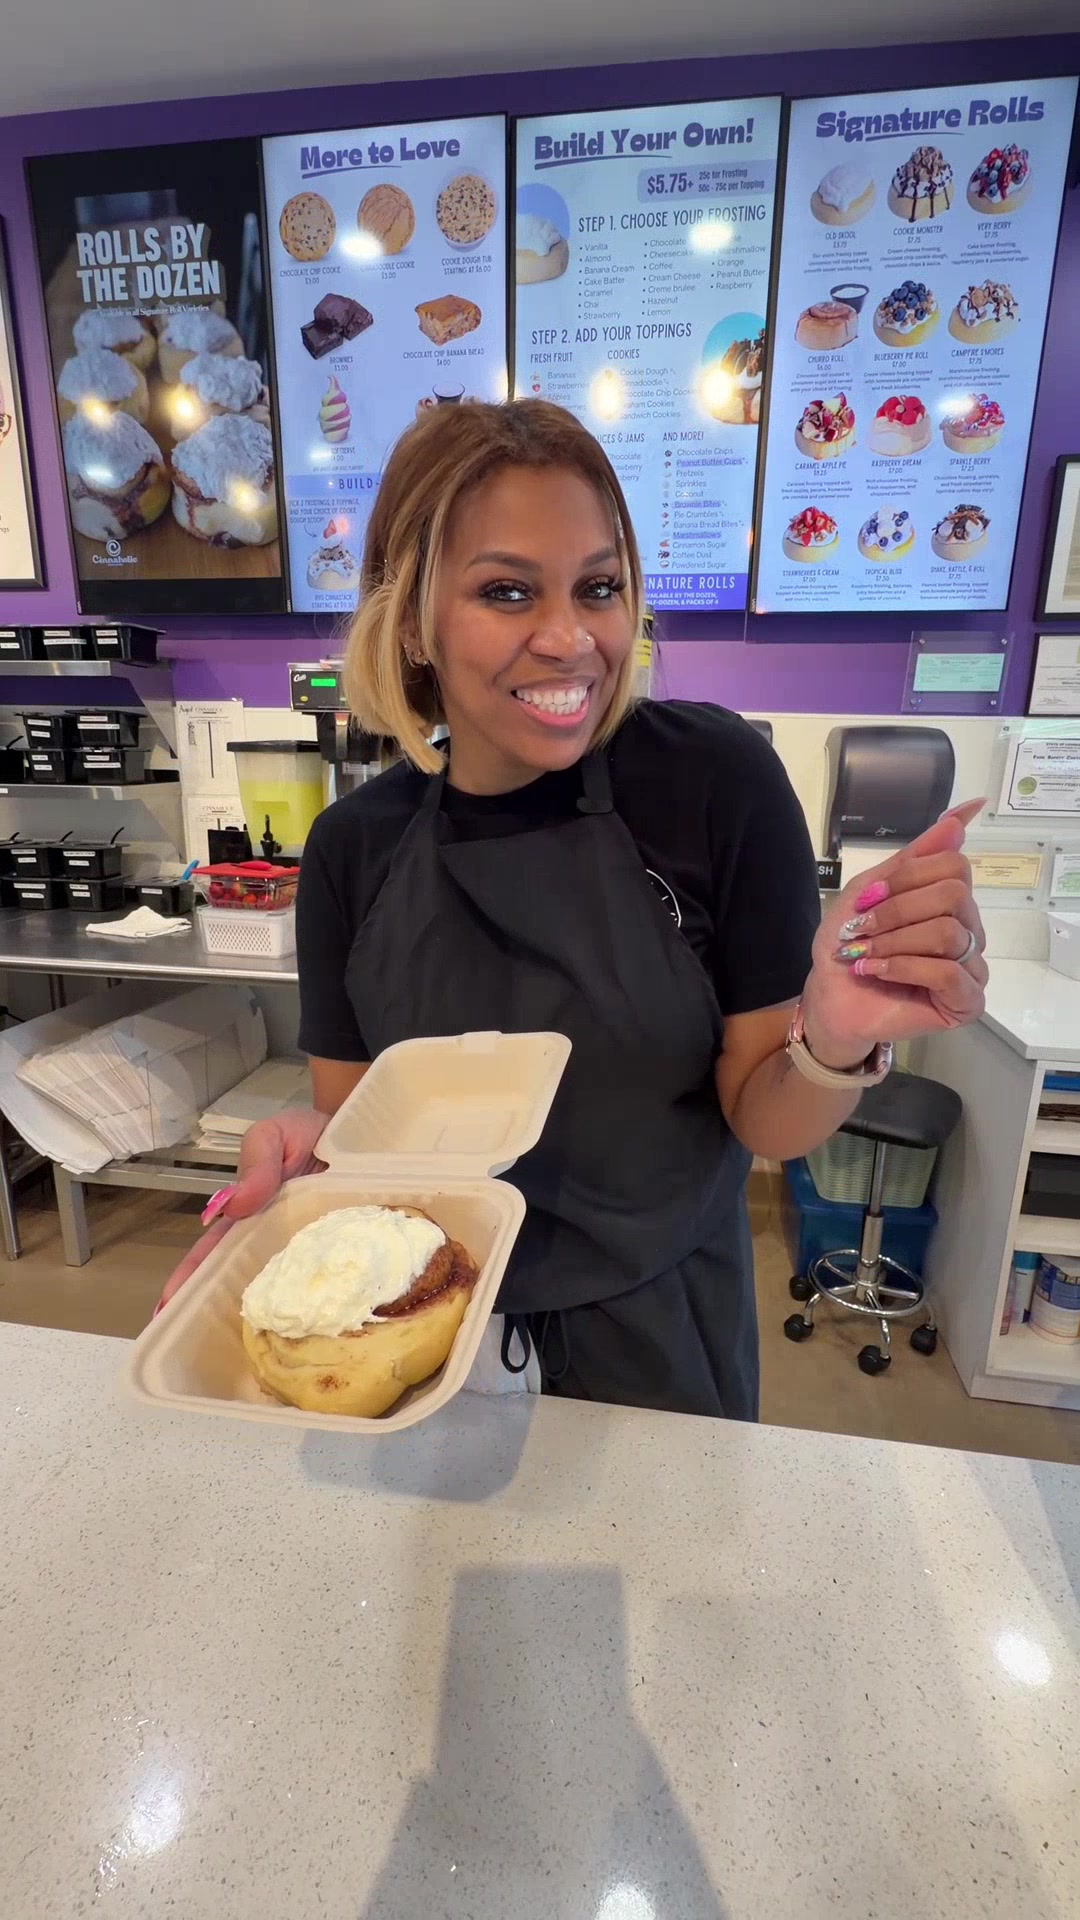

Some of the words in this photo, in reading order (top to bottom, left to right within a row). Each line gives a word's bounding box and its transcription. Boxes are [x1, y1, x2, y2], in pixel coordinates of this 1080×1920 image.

[816, 108, 961, 142] Signature
[967, 96, 1045, 126] Rolls
[535, 130, 604, 160] Build
[611, 128, 677, 153] Your
[683, 118, 754, 148] Own!
[300, 146, 363, 170] More
[368, 141, 394, 163] to
[400, 137, 460, 161] Love
[647, 172, 693, 196] $5.75+
[712, 170, 721, 180] for
[722, 168, 748, 179] Frosting
[740, 179, 765, 191] Topping
[578, 217, 605, 233] STEP
[610, 216, 616, 231] 1.
[620, 211, 668, 230] CHOOSE
[673, 208, 703, 226] YOUR
[708, 205, 766, 224] FROSTING
[893, 227, 914, 236] COOKIE
[916, 226, 943, 235] MONSTER
[977, 223, 992, 231] VERY
[993, 222, 1012, 230] BERRY
[825, 232, 836, 240] OLD
[76, 227, 162, 267] ROLLS
[170, 223, 205, 260] BY
[584, 243, 608, 252] Vanilla
[650, 238, 687, 248] Chocolate
[585, 255, 611, 263] Almond
[649, 250, 694, 260] Cheesecake
[396, 261, 415, 270] COOKIE
[441, 257, 461, 266] COOKIE
[462, 257, 481, 265] DOUGH
[483, 256, 493, 264] TUB
[717, 259, 744, 269] Orange
[444, 267, 467, 275] STARTING
[468, 266, 474, 274] AT
[475, 265, 492, 274] $6.00
[584, 267, 610, 275] Banana
[611, 265, 635, 273] Cream
[649, 262, 673, 271] Coffee
[279, 269, 309, 278] CHOCOLATE
[310, 268, 321, 276] CHIP
[322, 266, 341, 275] COOKIE
[717, 270, 741, 279] Peanut
[743, 269, 765, 277] Butter
[76, 267, 129, 303] THE
[136, 260, 221, 300] DOZEN
[584, 278, 602, 287] Cake
[604, 277, 625, 285] Batter
[648, 274, 672, 283] Cream
[673, 272, 700, 281] Cheese
[648, 286, 671, 295] Creme
[672, 284, 696, 293] brulee
[715, 282, 752, 291] Raspberry
[583, 289, 613, 298] Caramel
[583, 301, 599, 309] Chai
[647, 297, 678, 306] Hazelnut
[140, 307, 169, 317] Signature
[170, 306, 182, 315] Roll
[182, 304, 209, 314] Varieties
[647, 309, 671, 317] Lemon
[583, 312, 621, 321] Strawberry
[532, 330, 557, 345] STEP
[561, 329, 571, 344] 2.
[575, 327, 598, 343] ADD
[602, 325, 632, 341] YOUR
[636, 322, 692, 339] TOPPINGS
[403, 351, 433, 359] CHOCOLATE
[434, 350, 445, 358] CHIP
[446, 349, 467, 357] BANANA
[468, 348, 484, 356] BREAD
[530, 353, 551, 364] FRESH
[554, 352, 573, 362] FRUIT
[607, 349, 640, 360] COOKIES
[874, 352, 903, 361] BLUEBERRY
[904, 352, 913, 360] PIE
[951, 349, 978, 357] CAMPFIRE
[329, 356, 353, 364] BROWNIES
[547, 372, 576, 380] Bananas
[620, 368, 644, 377] Cookie
[646, 368, 668, 377] Dough
[656, 389, 671, 398] Chip
[647, 400, 675, 408] Cookies
[652, 410, 681, 419] Cookies
[618, 432, 623, 443] &
[624, 433, 645, 443] JAMS
[662, 432, 677, 442] AND
[680, 430, 704, 440] MORE!
[714, 447, 733, 456] Chips
[677, 459, 700, 467] Peanut
[701, 458, 724, 467] Butter
[725, 457, 742, 466] Cups
[795, 462, 820, 470] CARAMEL
[821, 461, 837, 469] APPLE
[973, 457, 991, 465] BERRY
[675, 480, 707, 488] Sprinkles
[675, 490, 703, 498] Coconut
[686, 510, 718, 518] Crumbles
[673, 521, 698, 529] Banana
[699, 520, 720, 528] Bread
[721, 519, 738, 527] Bites
[672, 531, 722, 540] Marshmallows
[672, 541, 706, 549] Cinnamon
[707, 541, 726, 550] Sugar
[92, 554, 138, 564] Cinnaholic
[672, 551, 695, 559] Coffee
[696, 551, 712, 559] Dust
[672, 561, 705, 569] Powdered
[707, 561, 726, 570] Sugar
[699, 576, 736, 589] ROLLS
